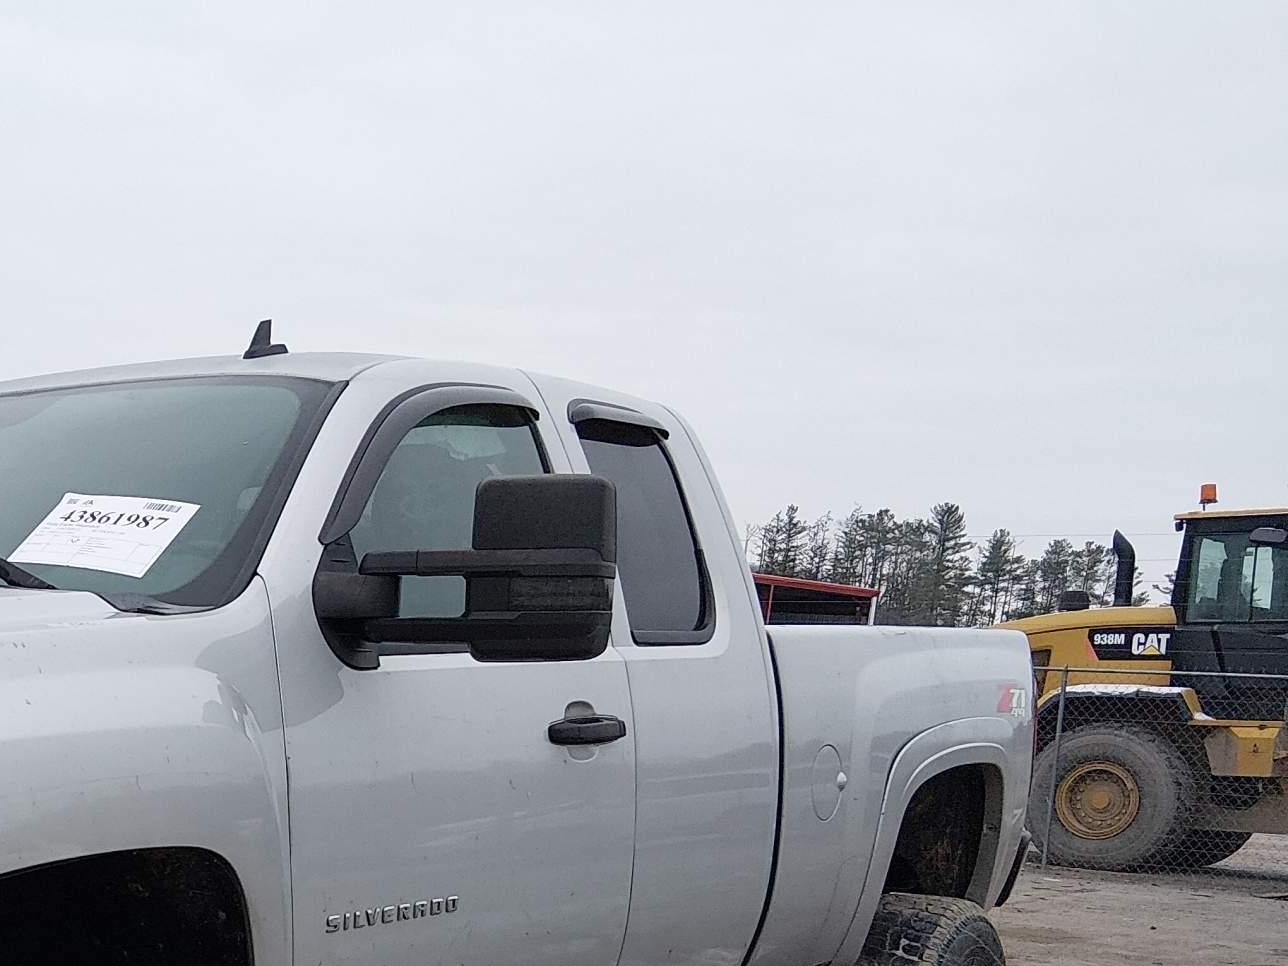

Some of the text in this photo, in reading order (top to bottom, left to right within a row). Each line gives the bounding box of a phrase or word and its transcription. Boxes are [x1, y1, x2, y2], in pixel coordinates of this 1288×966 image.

[59, 509, 170, 531] 43861987
[1093, 633, 1171, 656] 938M CAT
[325, 895, 460, 934] SILVERADO
